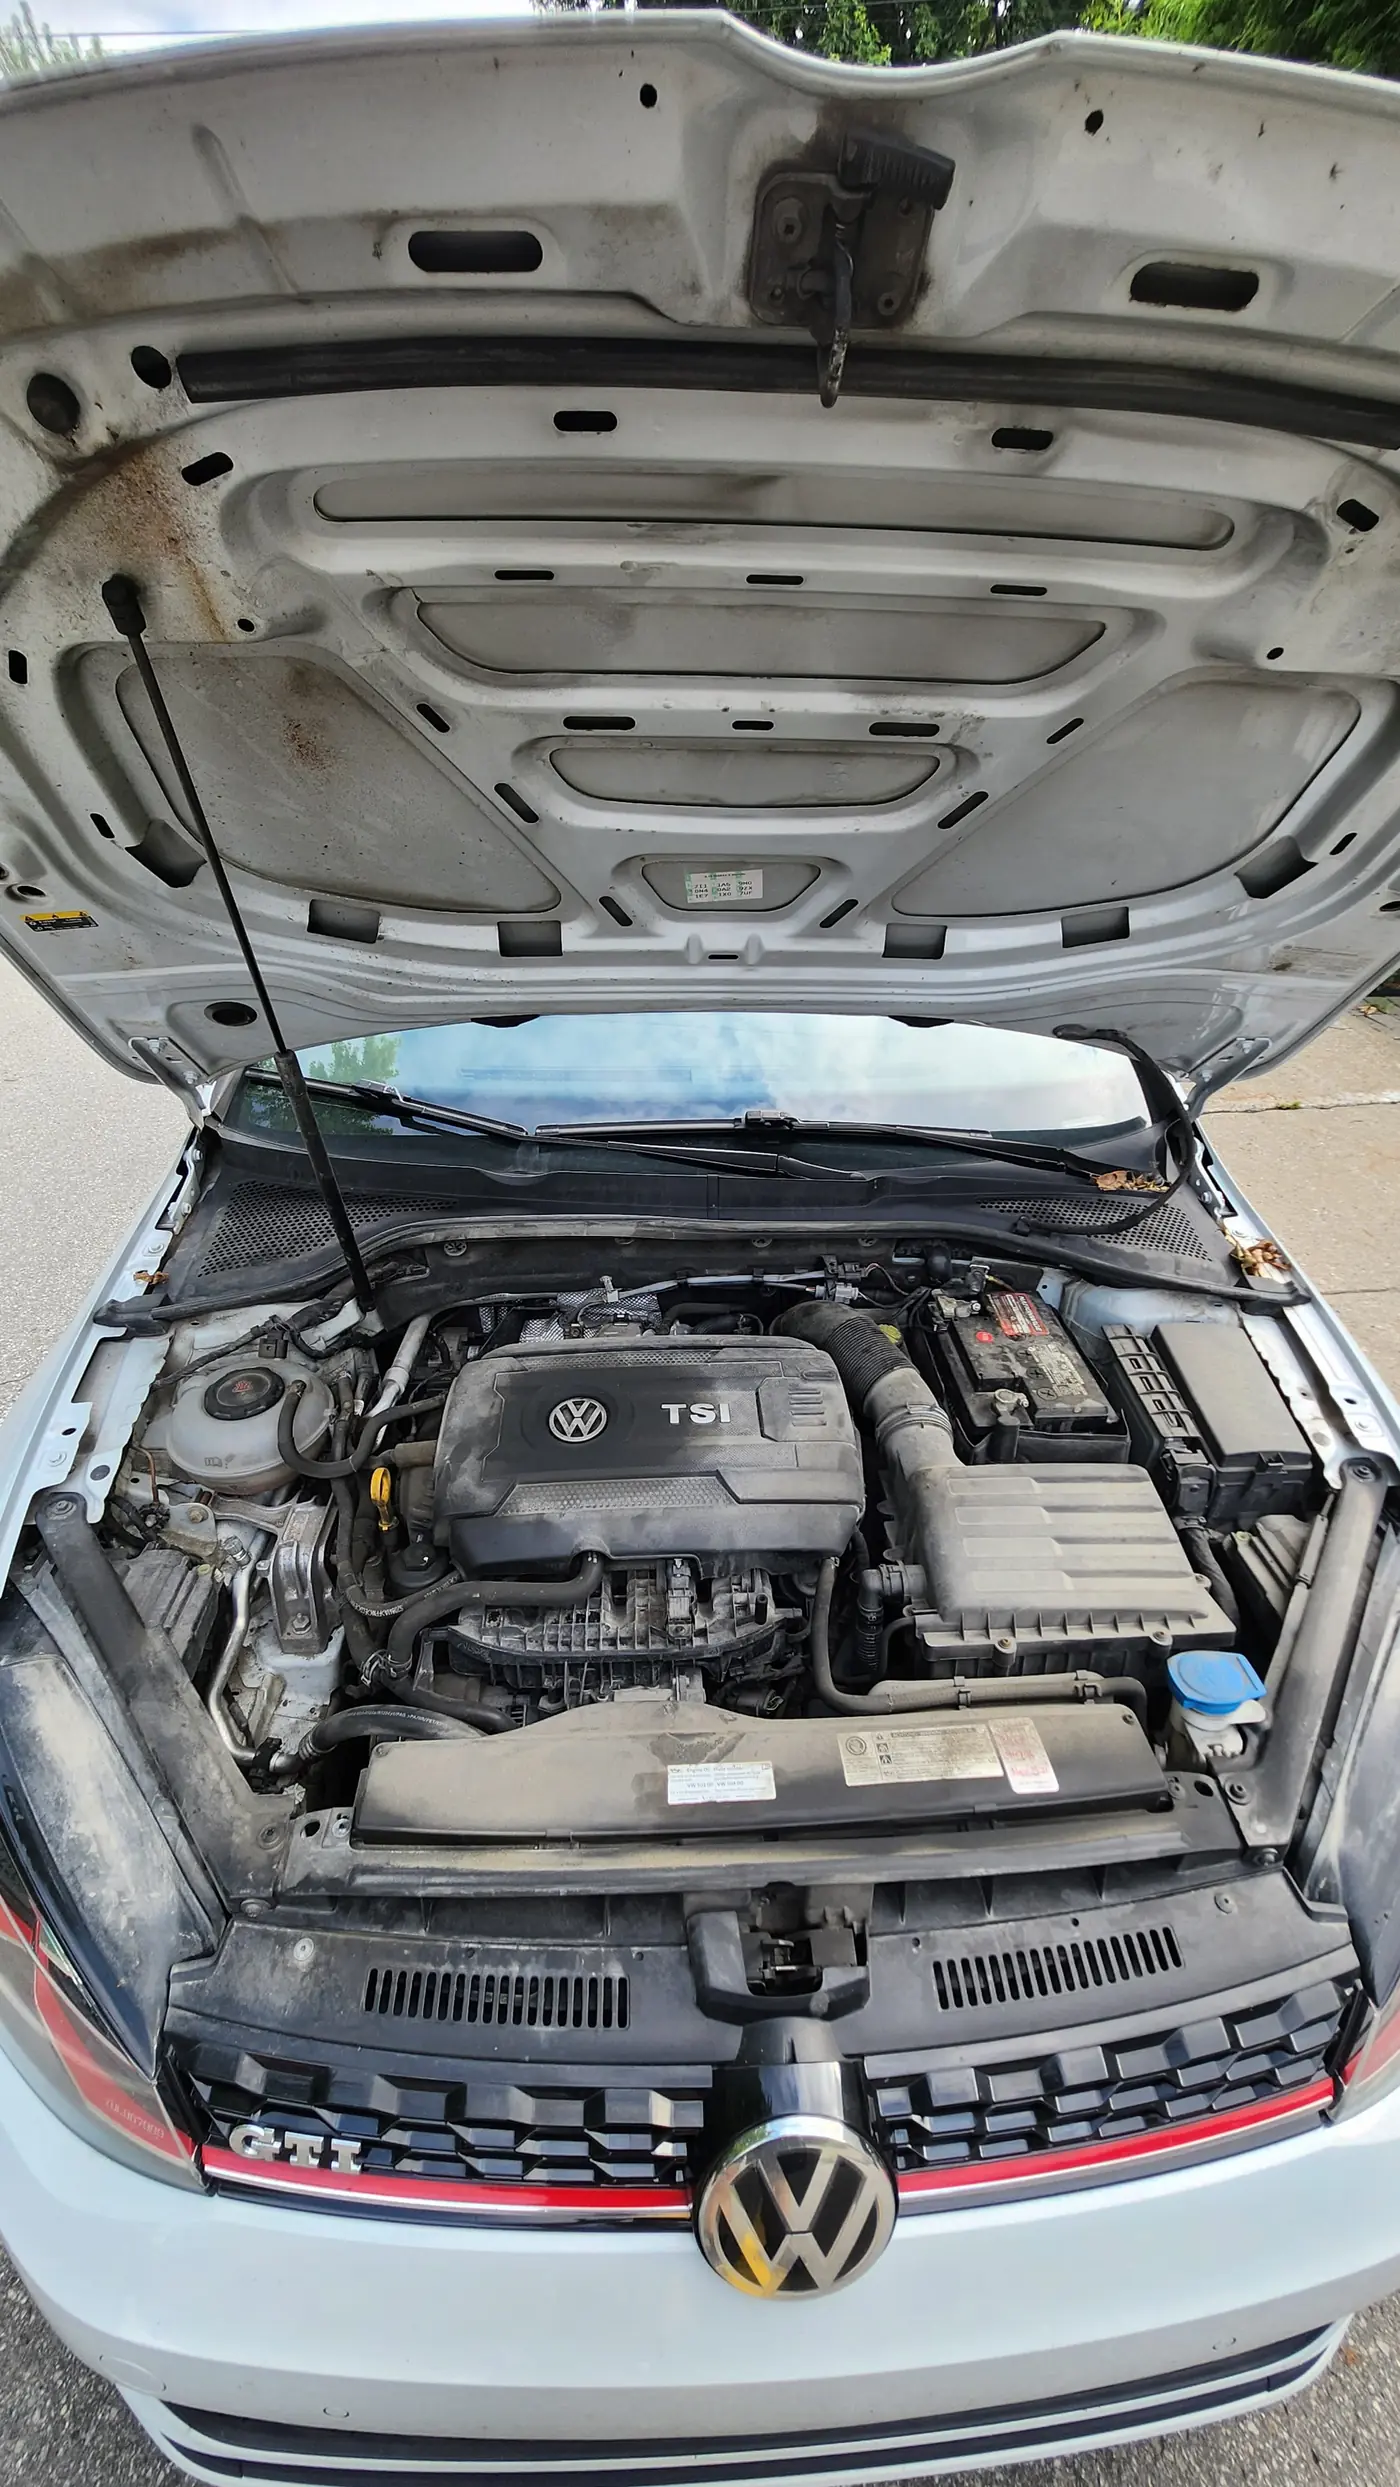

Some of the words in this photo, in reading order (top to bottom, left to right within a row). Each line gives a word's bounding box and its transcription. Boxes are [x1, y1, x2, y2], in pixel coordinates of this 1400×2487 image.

[549, 1397, 607, 1442] VW
[661, 1403, 731, 1425] TSI
[229, 2124, 361, 2175] GTI
[702, 2139, 894, 2299] VW
